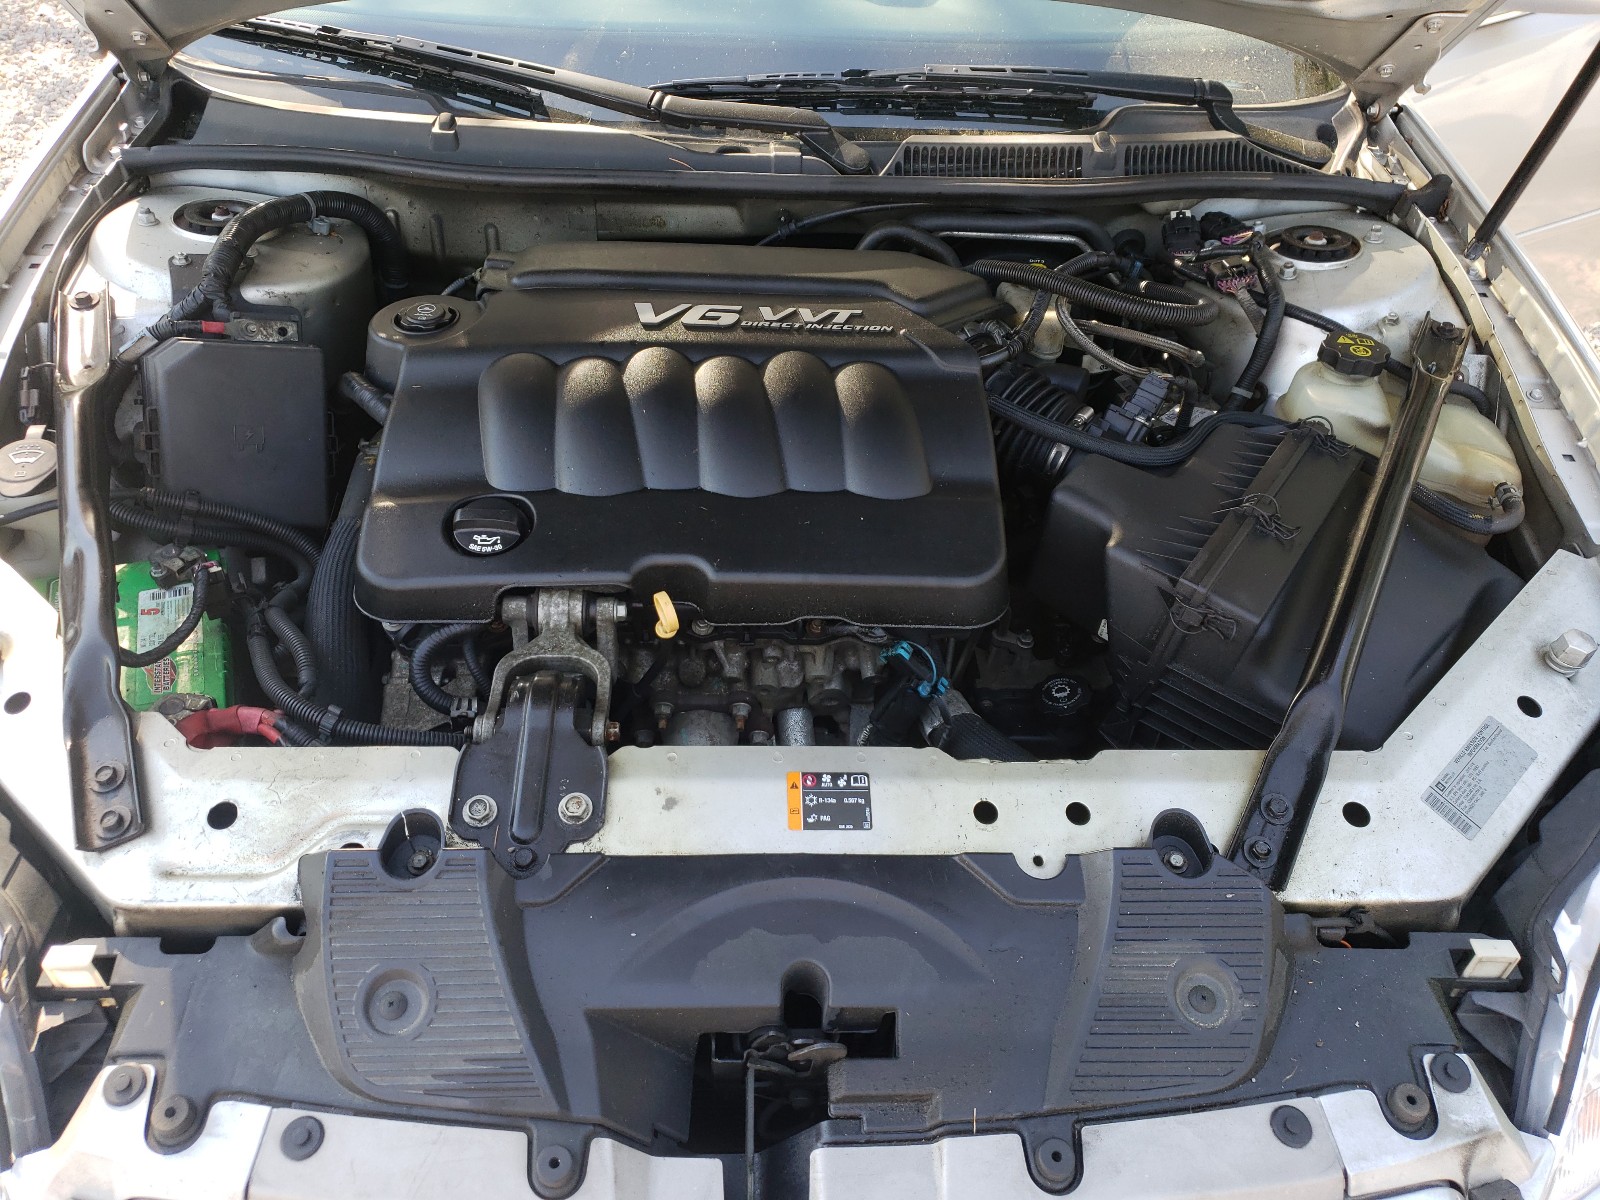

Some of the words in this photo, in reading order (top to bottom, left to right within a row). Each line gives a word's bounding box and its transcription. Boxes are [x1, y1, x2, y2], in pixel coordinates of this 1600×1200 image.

[634, 302, 743, 329] V6
[758, 306, 863, 325] VVT
[740, 320, 801, 330] DIRECT
[805, 322, 895, 333] INJECTION
[468, 543, 481, 551] SAE
[481, 543, 503, 552] 5W-30
[140, 607, 160, 615] 5
[153, 660, 161, 692] INTERSTAT
[162, 657, 170, 690] BATTERIES
[858, 797, 865, 805] kg
